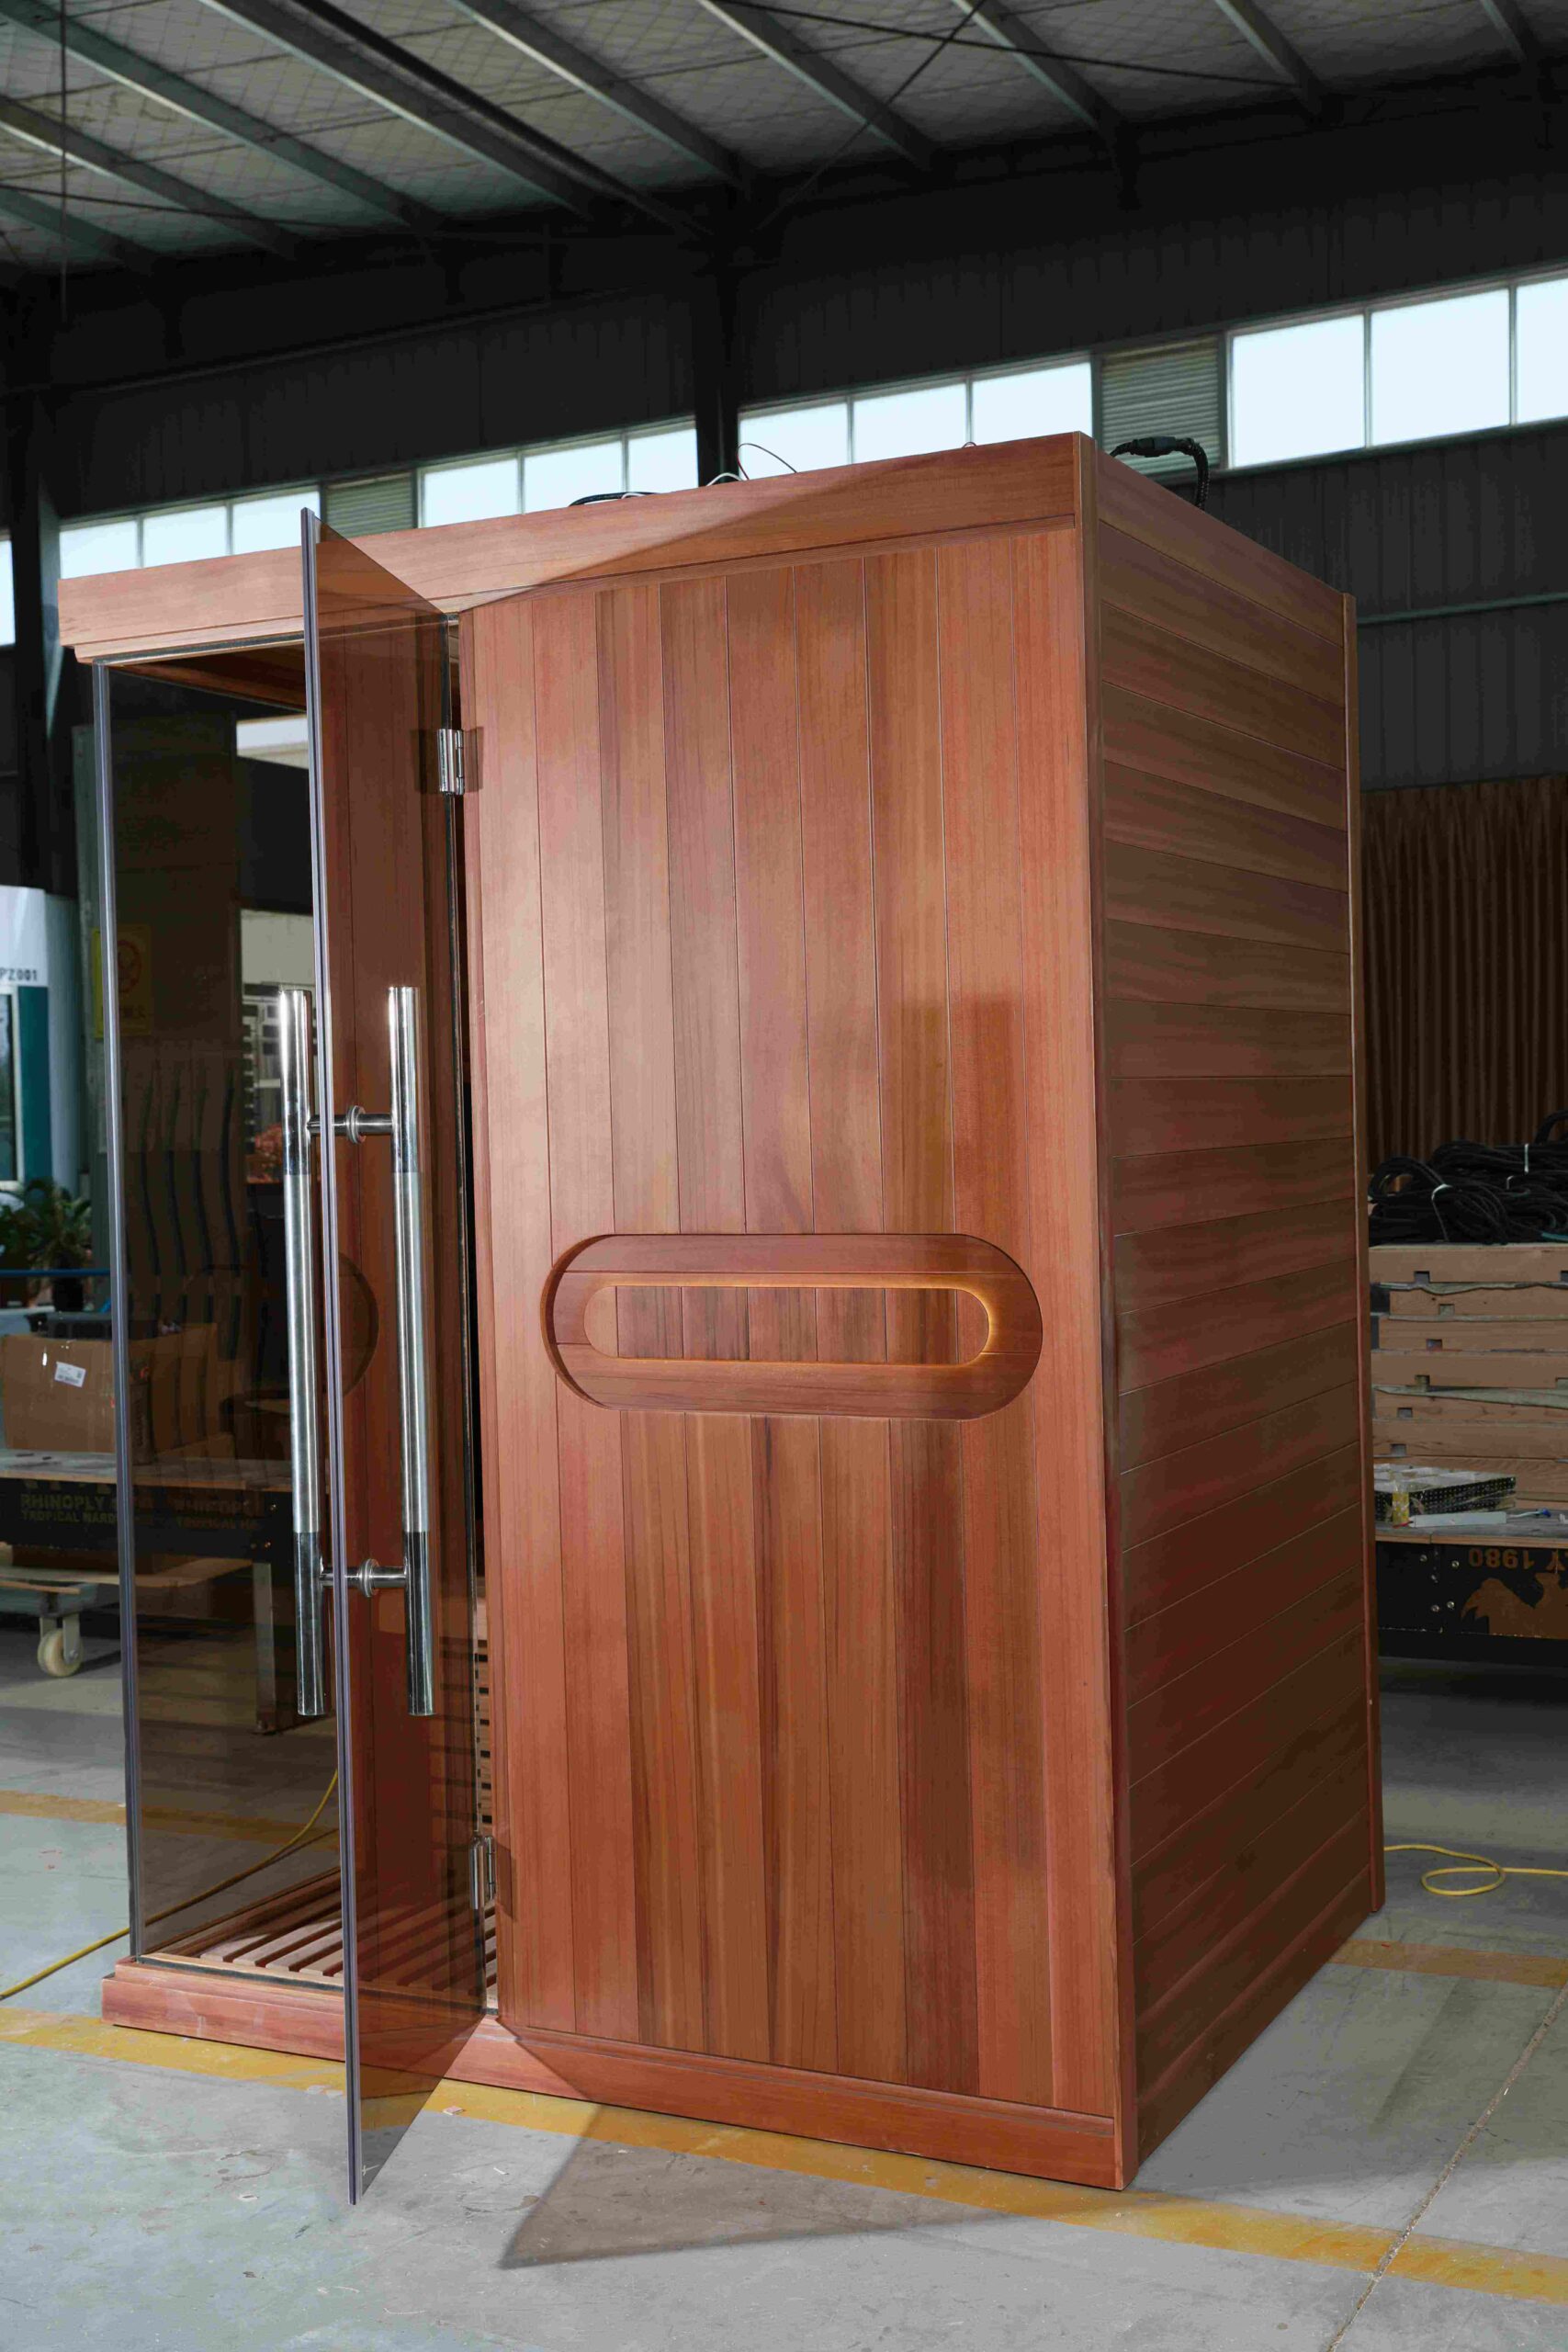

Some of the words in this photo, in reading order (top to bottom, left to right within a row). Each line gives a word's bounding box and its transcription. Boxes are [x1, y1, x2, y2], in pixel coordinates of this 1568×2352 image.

[20, 1493, 106, 1511] RHINOPLY
[21, 1510, 80, 1522] TROPICAL
[82, 1511, 118, 1525] HARD
[1469, 1547, 1536, 1570] 1980
